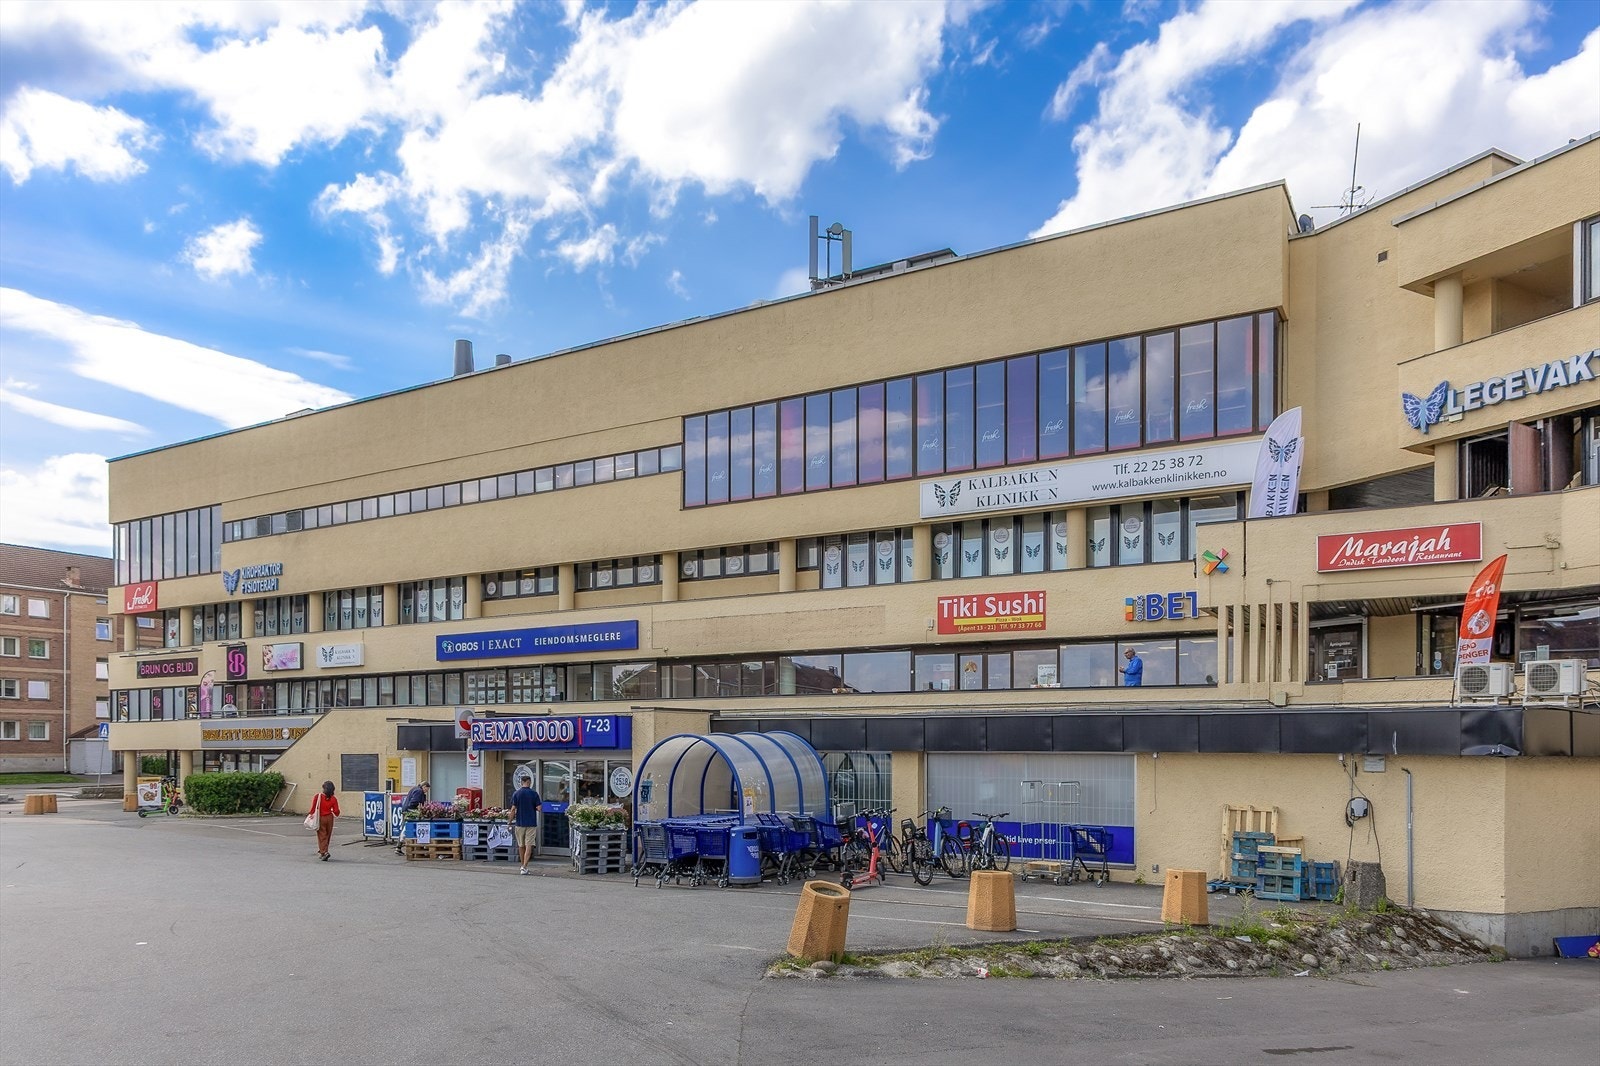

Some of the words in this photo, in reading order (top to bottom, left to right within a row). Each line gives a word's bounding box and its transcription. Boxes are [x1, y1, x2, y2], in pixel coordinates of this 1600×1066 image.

[1113, 464, 1130, 476] Tlf.
[1134, 461, 1148, 473] 22
[1152, 459, 1166, 471] 25
[1170, 457, 1185, 469] 38
[1188, 455, 1203, 467] 72
[1092, 469, 1227, 492] www.kalbakkenklinikken.no
[1330, 527, 1451, 565] Marajah
[1416, 551, 1462, 562] Restaurant
[241, 563, 283, 579] KIROPRAKTOR
[241, 578, 279, 594] FYSIOTERAPI
[939, 597, 977, 618] Tiki
[984, 593, 1044, 616] Sushi
[455, 642, 478, 652] OBOS
[488, 638, 522, 650] EXACT
[534, 632, 621, 646] EIENDOMSMEGLERE
[140, 664, 160, 675] BRUN
[162, 663, 174, 674] OG
[176, 661, 194, 673] BLID
[471, 721, 527, 742] REMA
[527, 720, 575, 742] 1000
[585, 718, 611, 732] 7-23
[366, 801, 377, 820] 59
[392, 806, 403, 830] 69
[417, 828, 426, 839] 99
